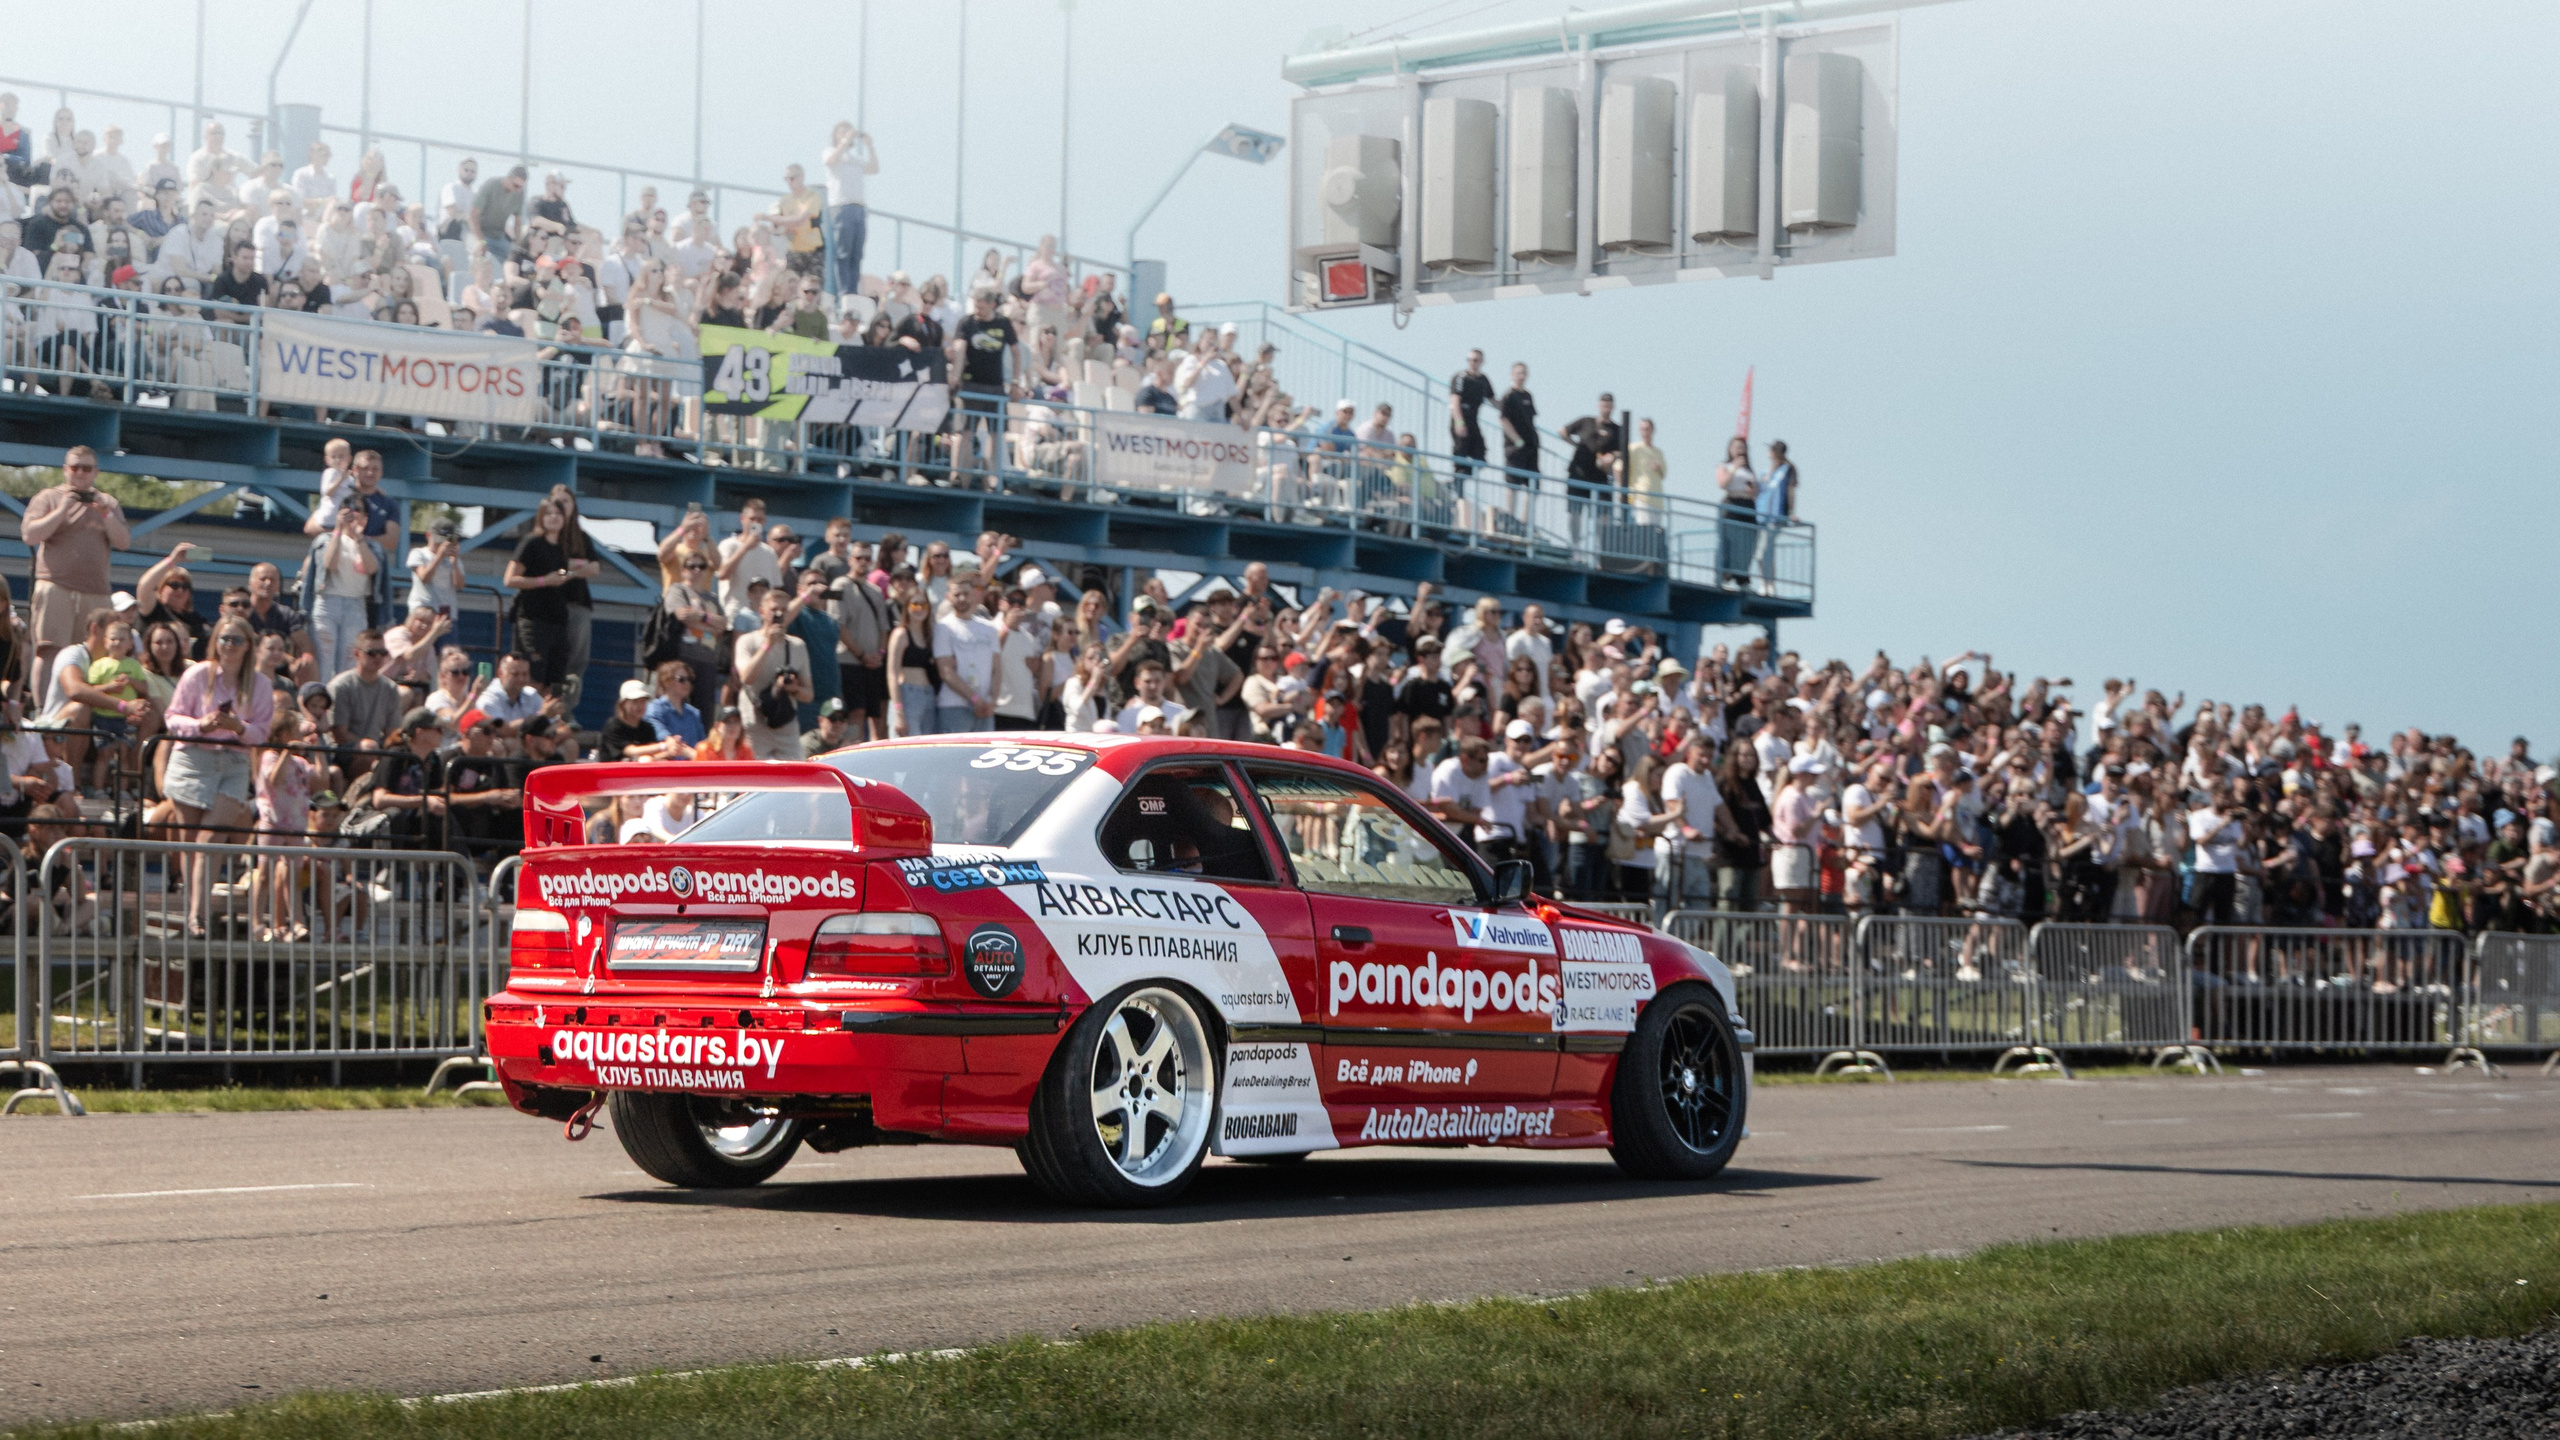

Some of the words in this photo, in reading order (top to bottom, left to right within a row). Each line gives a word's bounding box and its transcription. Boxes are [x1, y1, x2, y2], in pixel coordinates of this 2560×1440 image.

[277, 342, 525, 397] WESTMOTORS
[713, 344, 772, 402] 43
[1107, 432, 1249, 464] WESTMOTORS
[970, 748, 1088, 776] 555
[1139, 801, 1166, 812] OMP
[896, 858, 929, 872] НА
[538, 866, 669, 900] pandapods
[695, 868, 856, 902] pandapods
[548, 895, 563, 907] Всё
[564, 897, 580, 908] для
[582, 896, 611, 907] iPhone
[707, 890, 726, 903] Всё
[728, 894, 747, 904] для
[750, 892, 785, 904] iPhone
[1036, 883, 1240, 929] АКВАСТАРС
[699, 933, 721, 953] JP
[719, 933, 757, 953] DAY
[1078, 934, 1133, 956] КЛУБ
[1138, 935, 1238, 962] ПЛАВАНИЯ
[1486, 925, 1549, 947] Valvoline
[1559, 929, 1644, 963] BOOGABAND
[974, 964, 1016, 973] DETAILING
[975, 951, 1015, 965] AUTO
[1329, 951, 1557, 1024] pandapods
[1563, 971, 1651, 991] WESTMOTORS
[1221, 990, 1290, 1009] aquastars.by
[1570, 1006, 1596, 1021] RACE
[1597, 1008, 1624, 1022] LANE
[553, 1028, 785, 1079] aquastars.by
[1229, 1043, 1298, 1066] pandapods
[596, 1065, 642, 1086] КЛУБ
[645, 1068, 746, 1089] ПЛАВАНИЯ
[1232, 1075, 1311, 1089] AutoDetailingBrest
[1337, 1059, 1369, 1083] Всё
[1370, 1063, 1404, 1085] для
[1407, 1060, 1462, 1084] iPhone
[1224, 1112, 1298, 1140] BOOGABAND
[1360, 1105, 1555, 1144] AutoDetailingBrest
